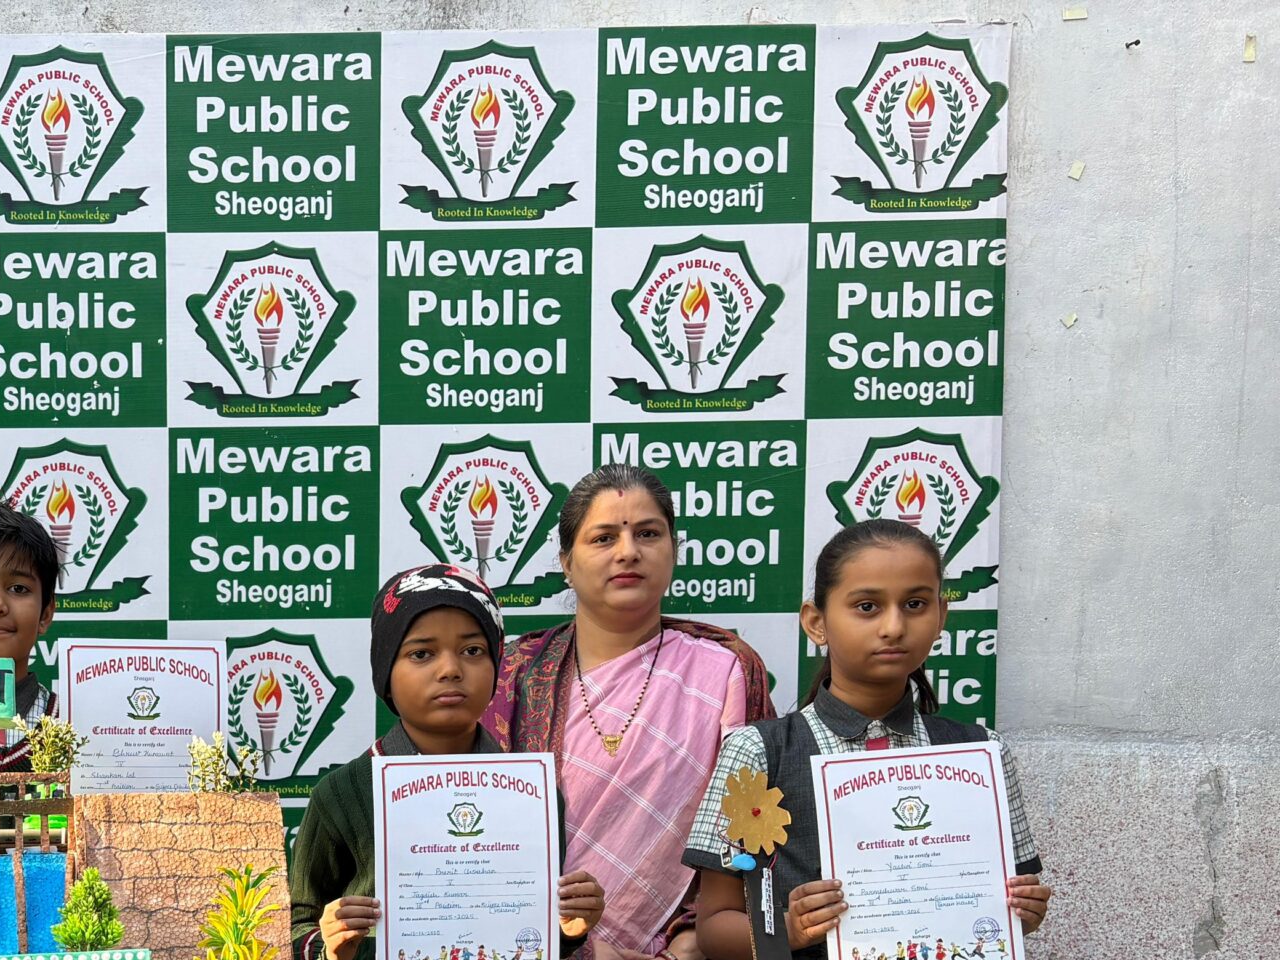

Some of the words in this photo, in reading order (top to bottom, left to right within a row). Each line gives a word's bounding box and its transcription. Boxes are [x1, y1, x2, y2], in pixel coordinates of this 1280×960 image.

[175, 46, 372, 82] Mewara
[607, 38, 806, 75] Mewara
[1, 79, 36, 126] MEWARA
[38, 69, 81, 81] PUBLIC
[83, 79, 113, 125] SCHOOL
[431, 74, 467, 122] MEWARA
[468, 64, 511, 78] PUBLIC
[514, 74, 544, 120] SCHOOL
[864, 65, 901, 112] MEWARA
[903, 56, 947, 69] PUBLIC
[948, 65, 978, 111] SCHOOL
[197, 95, 349, 133] Public
[628, 86, 783, 125] Public
[188, 145, 355, 183] School
[618, 137, 788, 177] School
[215, 191, 332, 220] Sheoganj
[644, 182, 763, 213] Sheoganj
[870, 198, 905, 208] Rooted
[907, 198, 917, 208] In
[920, 197, 972, 210] Knowledge
[11, 211, 44, 221] Rooted
[47, 211, 56, 221] In
[60, 211, 111, 224] Knowledge
[387, 241, 583, 276] Mewara
[816, 232, 1006, 271] Mewara
[214, 273, 249, 320] MEWARA
[250, 264, 294, 276] PUBLIC
[295, 274, 326, 319] SCHOOL
[640, 267, 677, 315] MEWARA
[678, 258, 722, 272] PUBLIC
[723, 267, 753, 313] SCHOOL
[838, 281, 993, 319] Public
[409, 289, 560, 326] Public
[400, 339, 566, 376] School
[828, 330, 998, 369] School
[4, 387, 119, 416] Sheoganj
[426, 383, 543, 412] Sheoganj
[648, 398, 680, 408] Rooted
[683, 398, 692, 408] In
[695, 398, 746, 410] Knowledge
[854, 375, 974, 405] Sheoganj
[177, 438, 371, 473] Mewara
[601, 433, 797, 468] Mewara
[9, 469, 41, 508] EWARA
[43, 462, 85, 475] PUBLIC
[87, 471, 117, 516] SCHOOL
[429, 466, 463, 512] MEWARA
[465, 457, 509, 469] PUBLIC
[511, 466, 540, 511] SCHOOL
[855, 459, 892, 507] MEWARA
[894, 451, 939, 463] PUBLIC
[939, 460, 970, 504] SCHOOL
[199, 486, 349, 522] Public
[190, 535, 354, 572] School
[677, 529, 779, 565] hool
[62, 600, 114, 611] Knowledge
[217, 580, 331, 608] Sheoganj
[663, 573, 755, 603] eoganj
[76, 657, 124, 684] MEWARA
[127, 656, 166, 672] PUBLIC
[169, 659, 214, 686] SCHOOL
[250, 651, 294, 663] PUBLIC
[295, 659, 324, 705] SCHOOL
[92, 726, 135, 735] Certificate
[139, 726, 147, 735] of
[150, 726, 192, 735] Excellence
[392, 774, 443, 802] MEWARA
[446, 771, 488, 788] PUBLIC
[492, 773, 542, 799] SCHOOL
[833, 769, 886, 800] MEWARA
[888, 764, 932, 782] PUBLIC
[936, 765, 990, 788] SCHOOL
[410, 844, 457, 853] Certificate
[460, 844, 469, 852] of
[473, 842, 520, 852] Excellence
[857, 839, 905, 850] Certificate
[909, 837, 918, 846] of
[922, 834, 971, 845] Excellence
